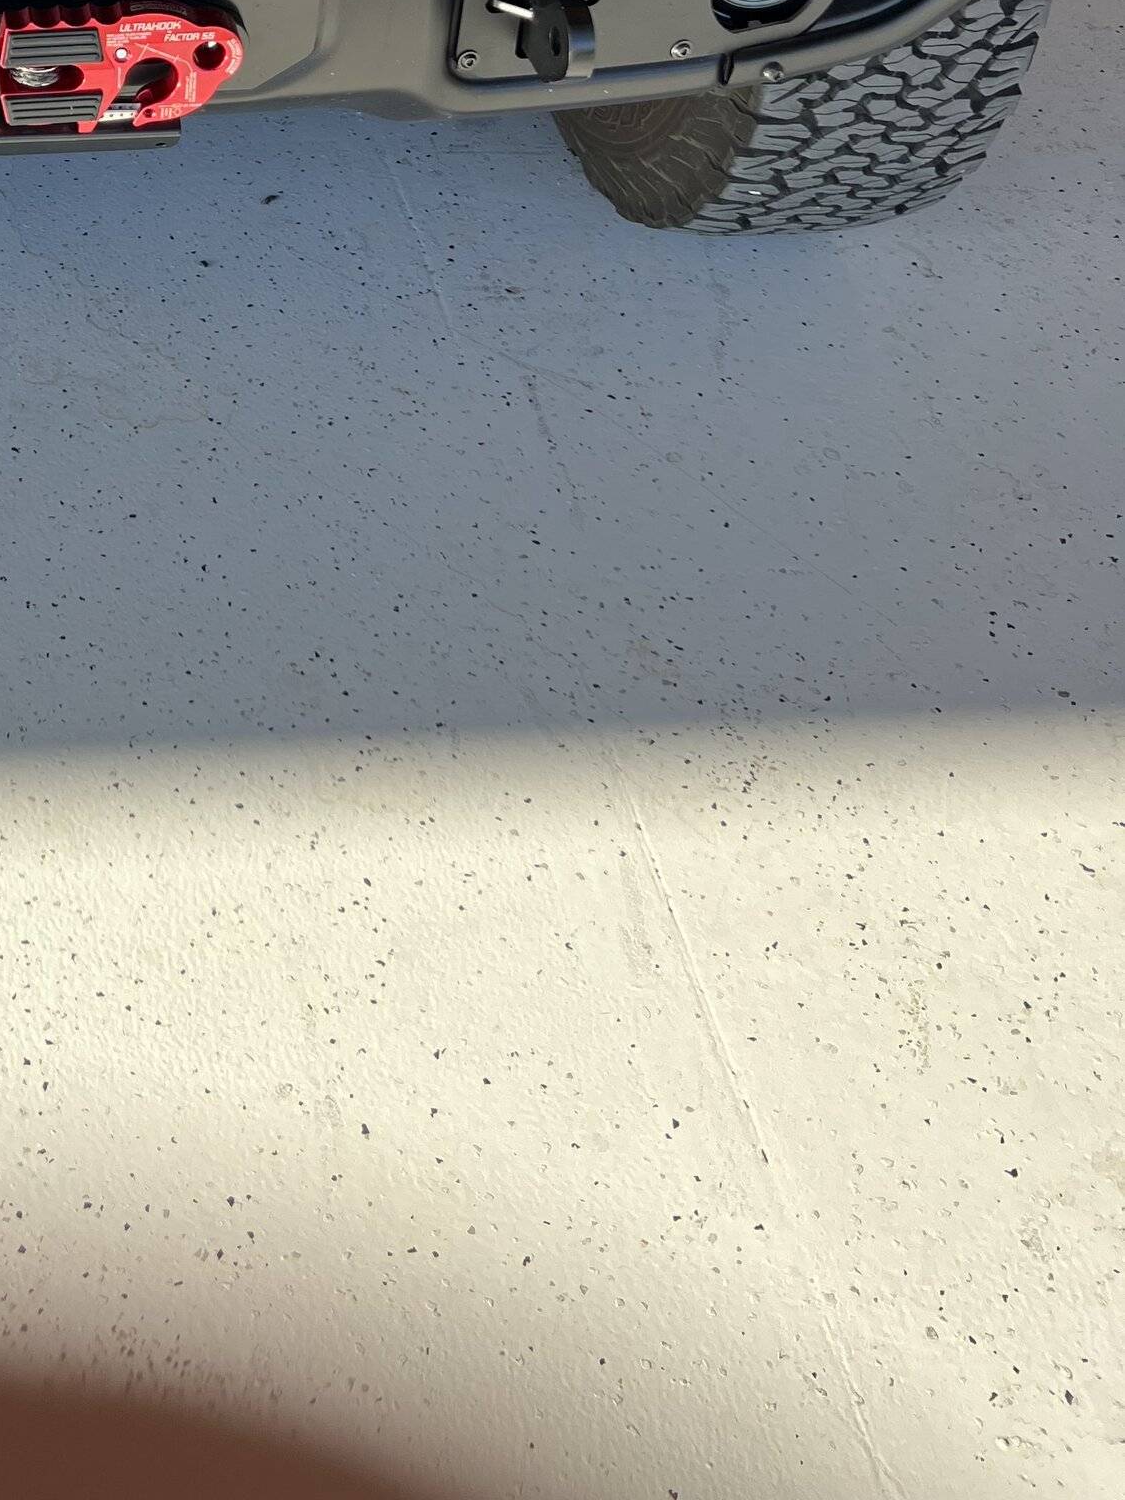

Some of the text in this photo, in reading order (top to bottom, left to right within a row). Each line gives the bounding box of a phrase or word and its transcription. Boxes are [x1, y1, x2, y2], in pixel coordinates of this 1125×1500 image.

[119, 21, 182, 32] ULTRAHOOK
[164, 32, 216, 42] FACTOR 55
